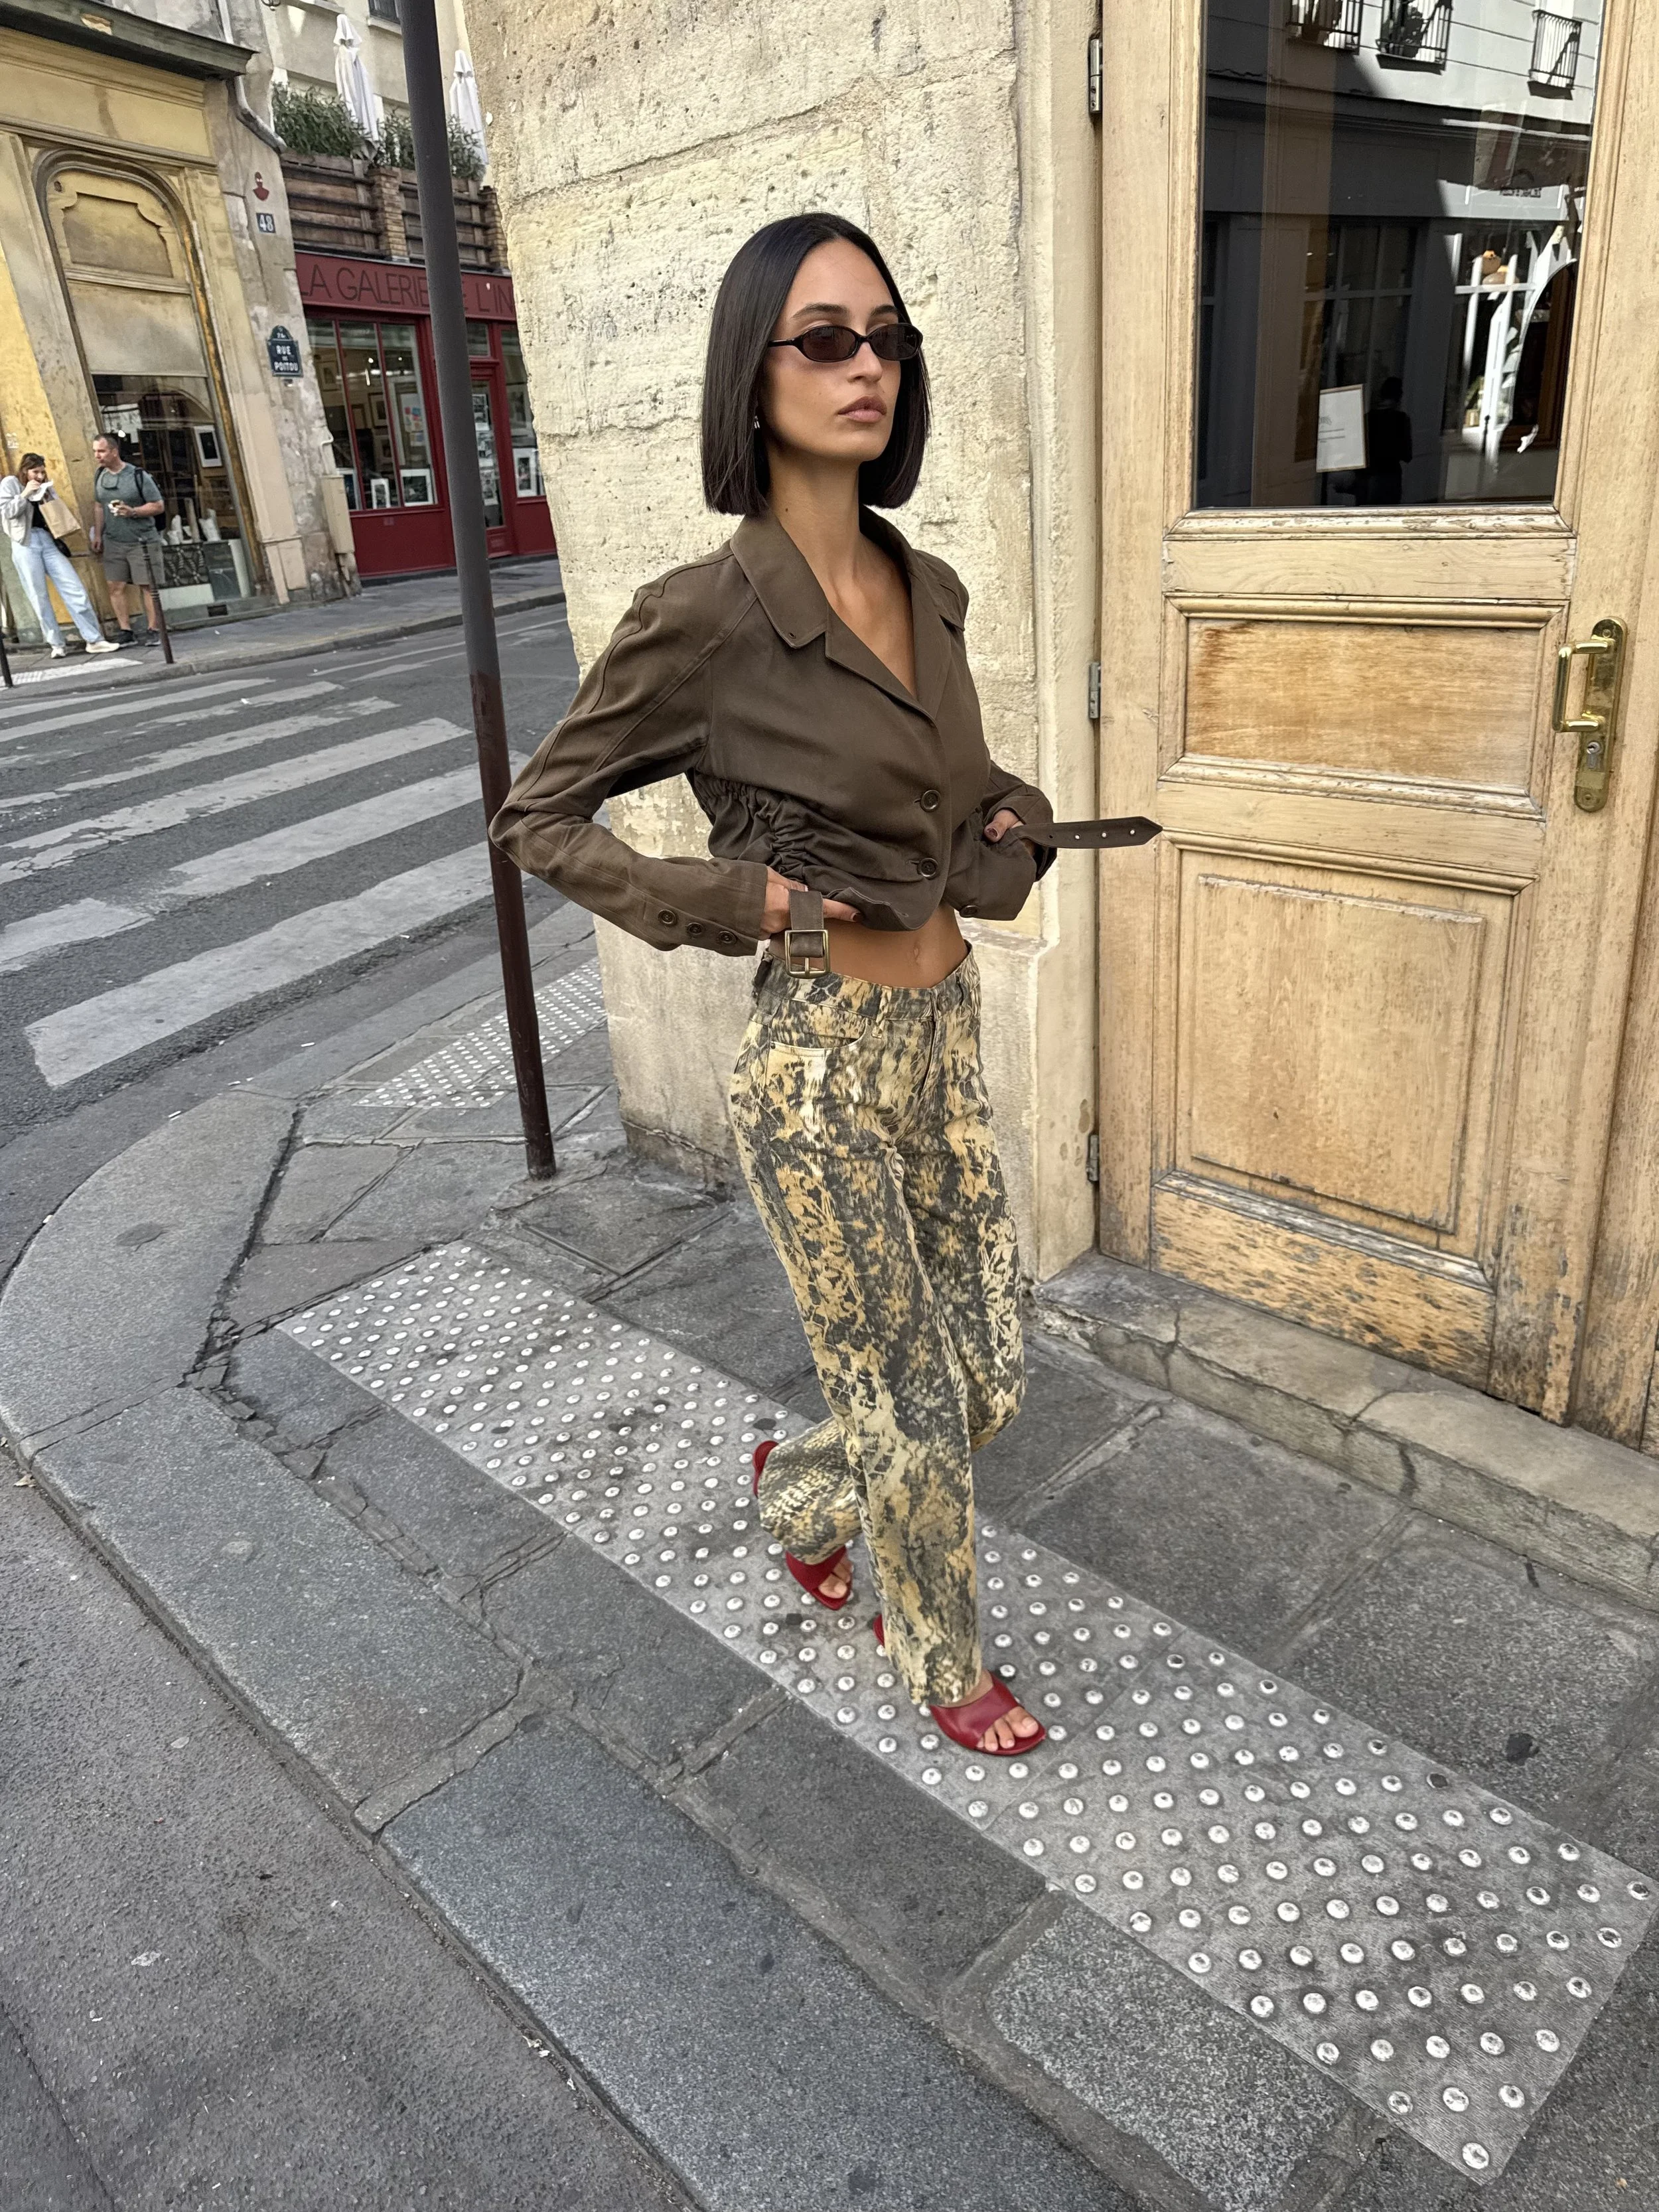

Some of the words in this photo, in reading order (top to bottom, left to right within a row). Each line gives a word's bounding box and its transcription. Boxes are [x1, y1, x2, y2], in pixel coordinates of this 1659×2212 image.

[259, 214, 273, 232] 48
[336, 267, 430, 308] GALERIE
[276, 345, 291, 355] RUE
[274, 361, 299, 371] POITOU
